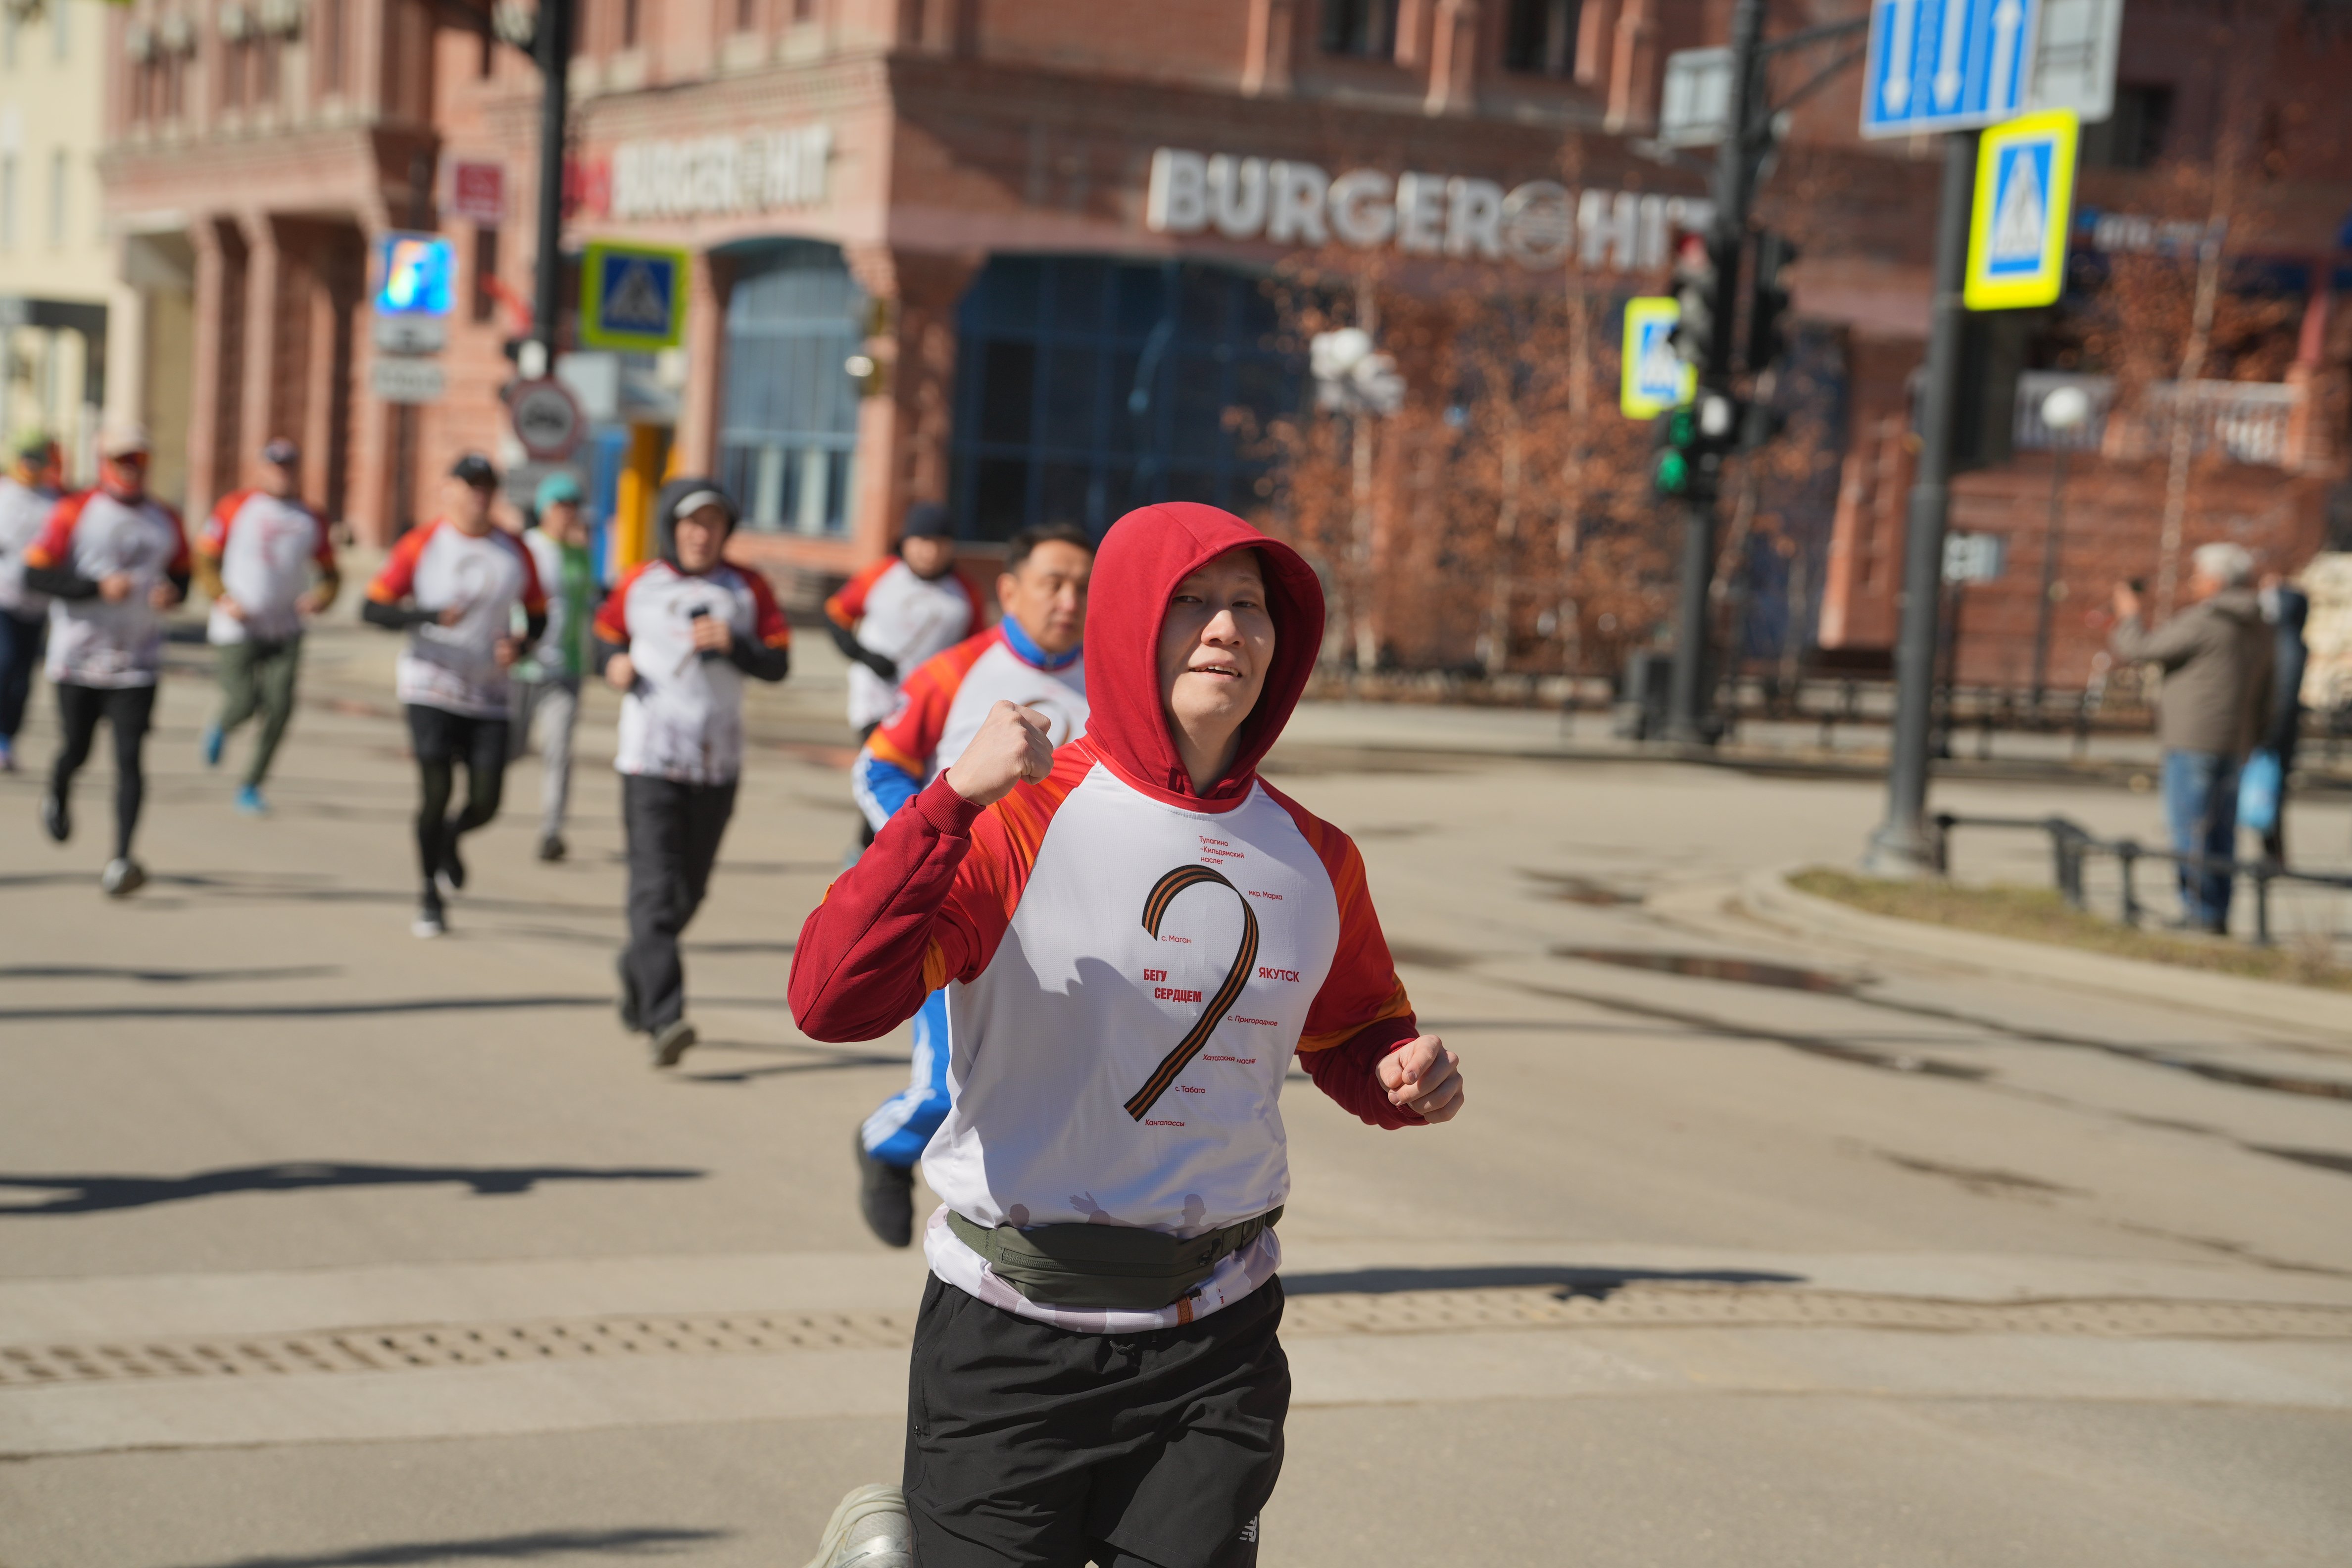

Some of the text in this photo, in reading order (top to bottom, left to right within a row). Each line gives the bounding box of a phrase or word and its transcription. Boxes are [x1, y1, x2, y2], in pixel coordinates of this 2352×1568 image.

[1146, 148, 1505, 259] BURGER
[1199, 835, 1228, 846] Тулагино
[1200, 846, 1244, 859] -Кильдямский
[1263, 891, 1283, 900] Марха
[1169, 935, 1191, 943] Маган
[1143, 969, 1167, 982] БЕГУ
[1259, 967, 1300, 982] ЯКУТСК
[1154, 987, 1202, 1003] СЕРДЦЕМ
[1234, 1015, 1278, 1026] Пригородное
